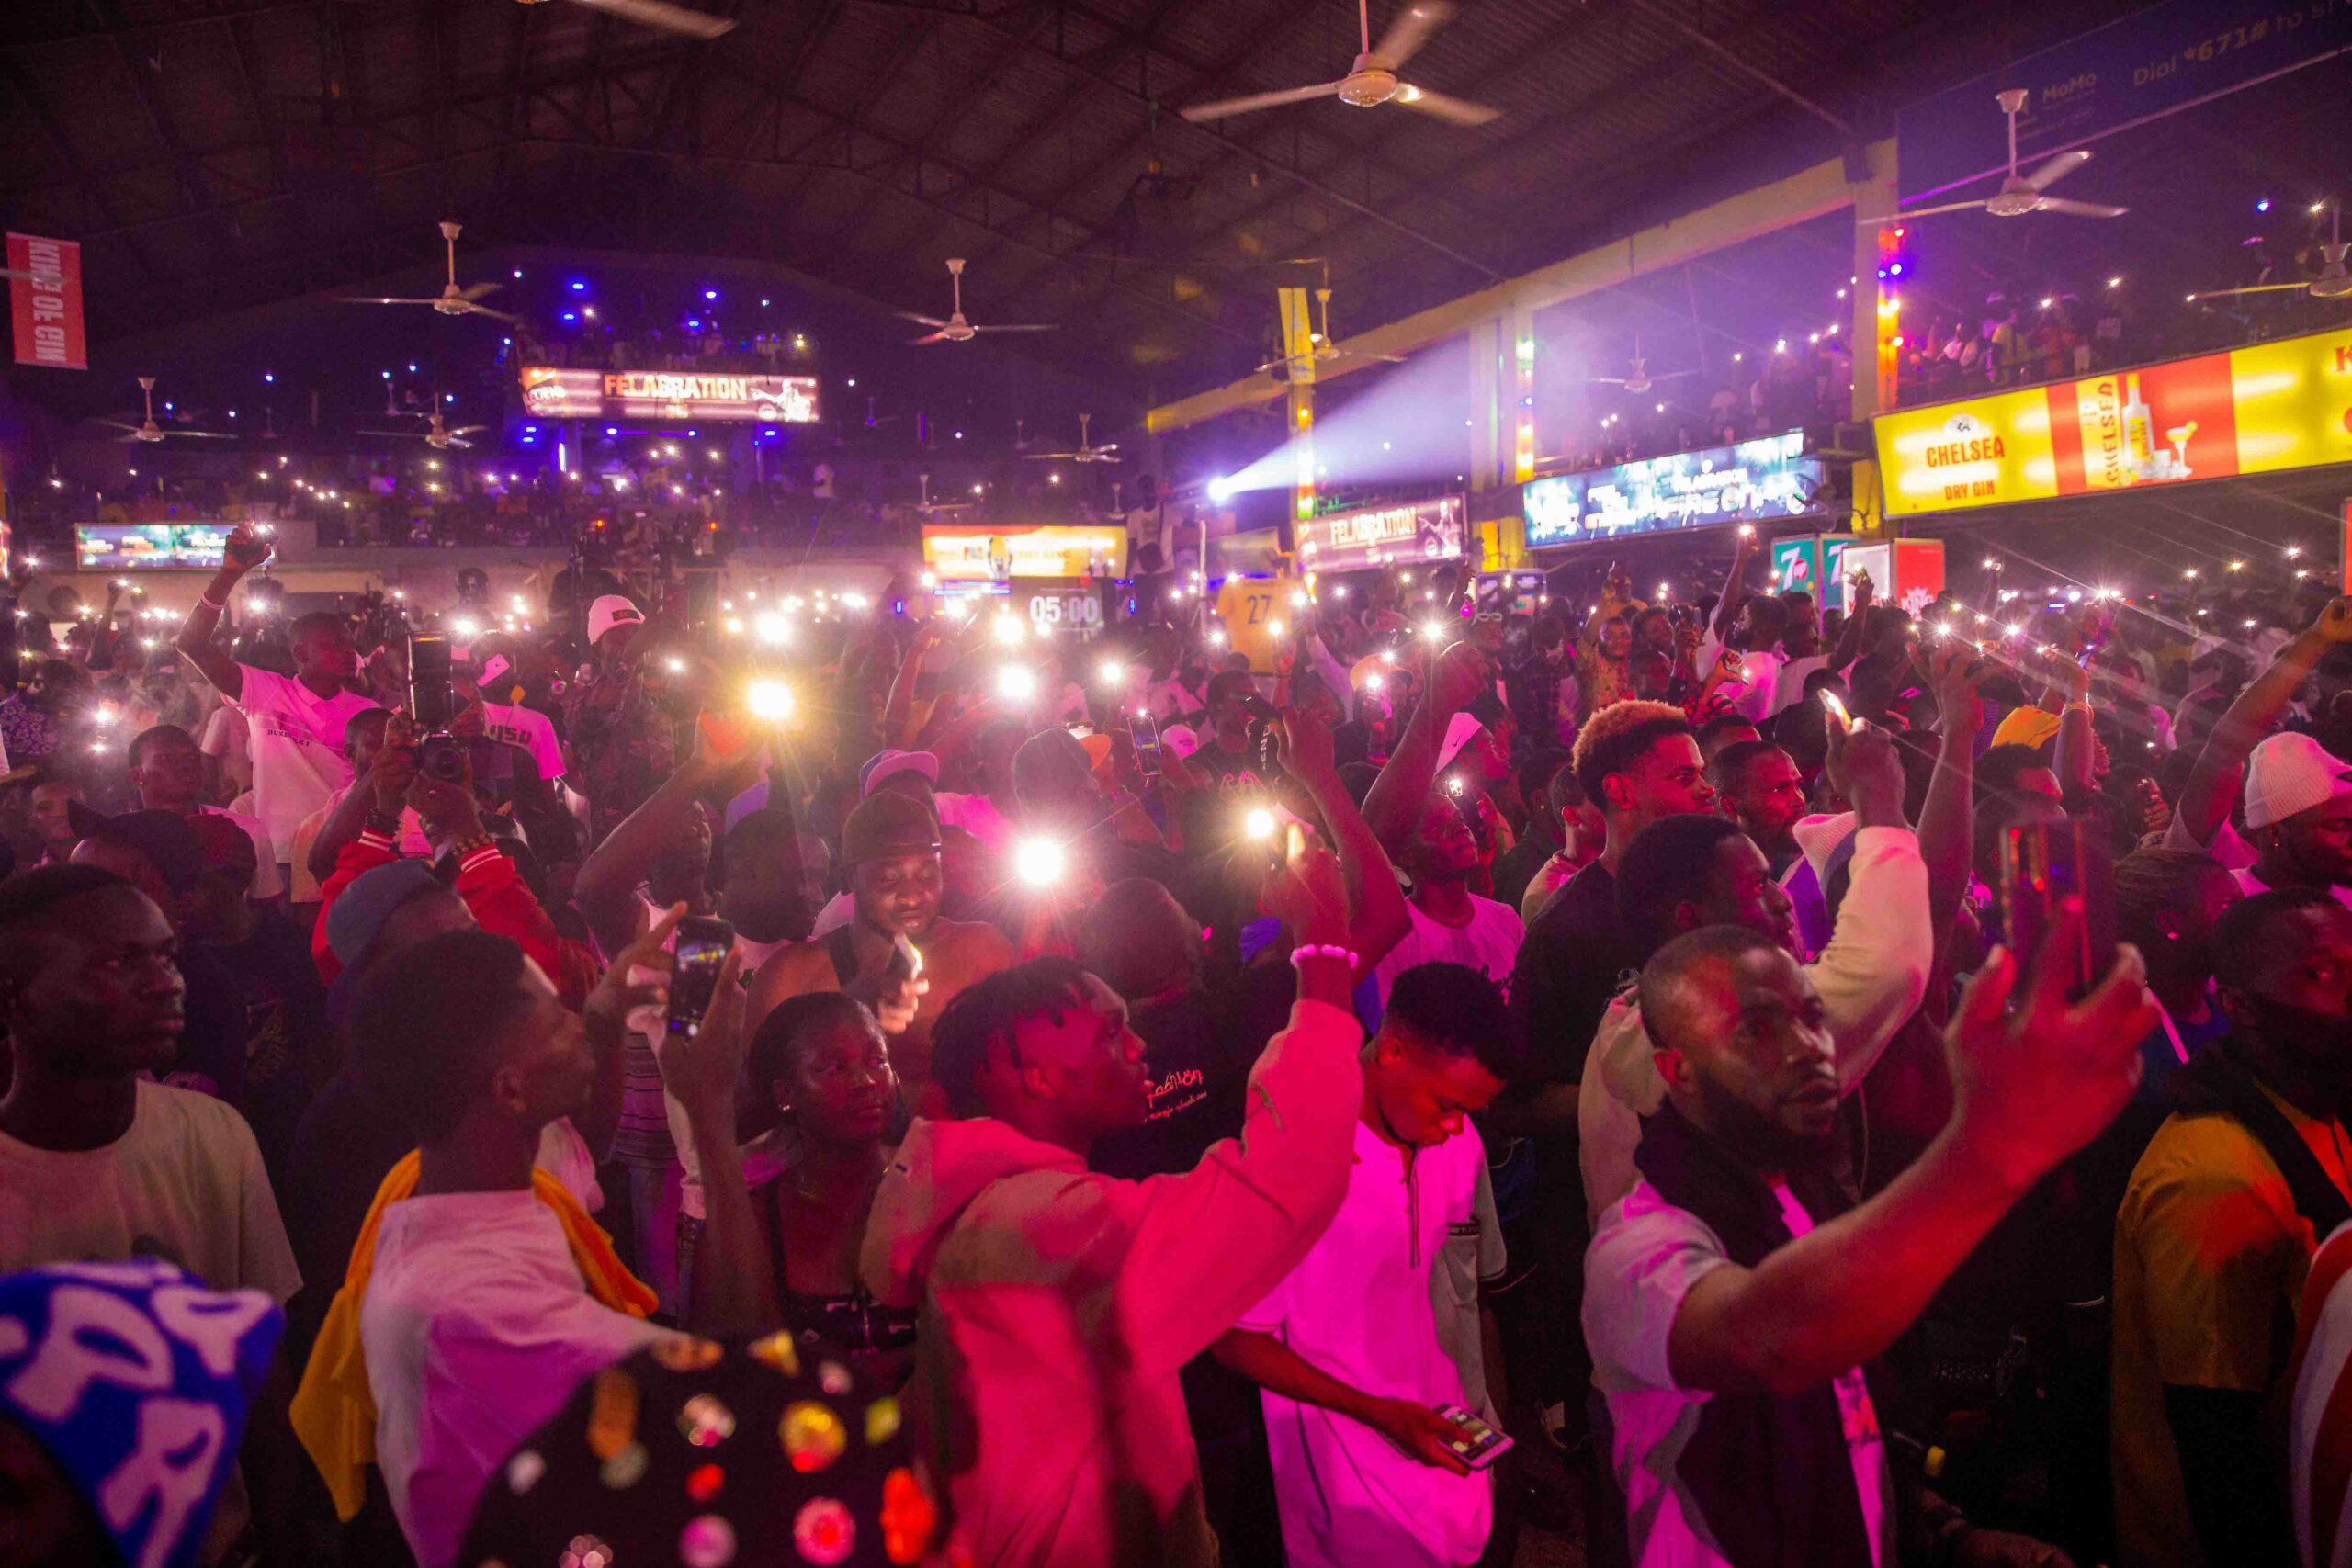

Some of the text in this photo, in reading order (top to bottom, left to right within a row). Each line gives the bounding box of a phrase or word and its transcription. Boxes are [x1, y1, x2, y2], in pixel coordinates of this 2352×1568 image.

[2133, 53, 2177, 86] Dial
[2043, 73, 2098, 104] MoMo
[604, 374, 748, 401] FELABRATION
[2098, 381, 2119, 483] CHELSEA
[1926, 434, 2006, 468] CHELSEA
[1944, 480, 1995, 501] DRY GIN
[1329, 506, 1417, 547] FELABRATION
[1029, 595, 1099, 623] 05:00
[1246, 594, 1272, 625] 27
